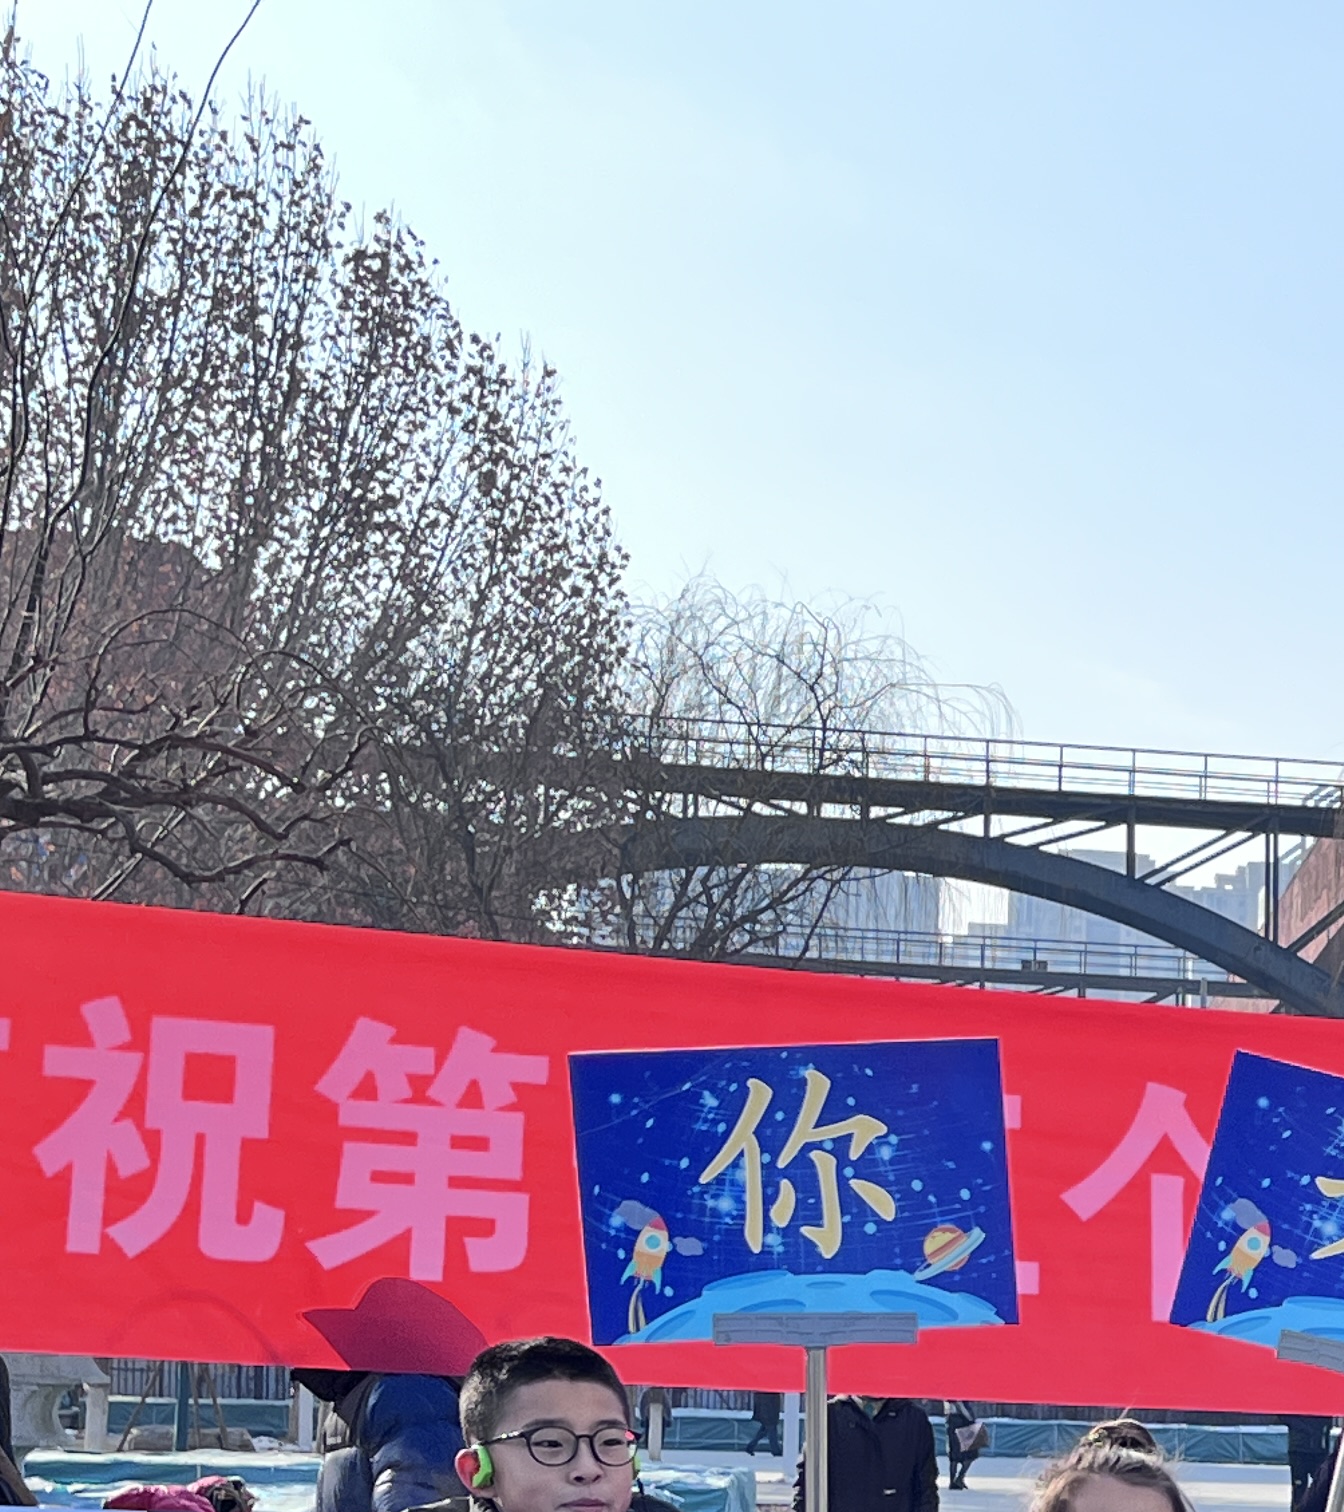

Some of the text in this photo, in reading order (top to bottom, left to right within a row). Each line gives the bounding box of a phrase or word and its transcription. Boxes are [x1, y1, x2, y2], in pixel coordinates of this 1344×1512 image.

[0, 996, 548, 1281] 祝第
[1012, 1083, 1210, 1322] 个
[699, 1069, 896, 1260] 你
